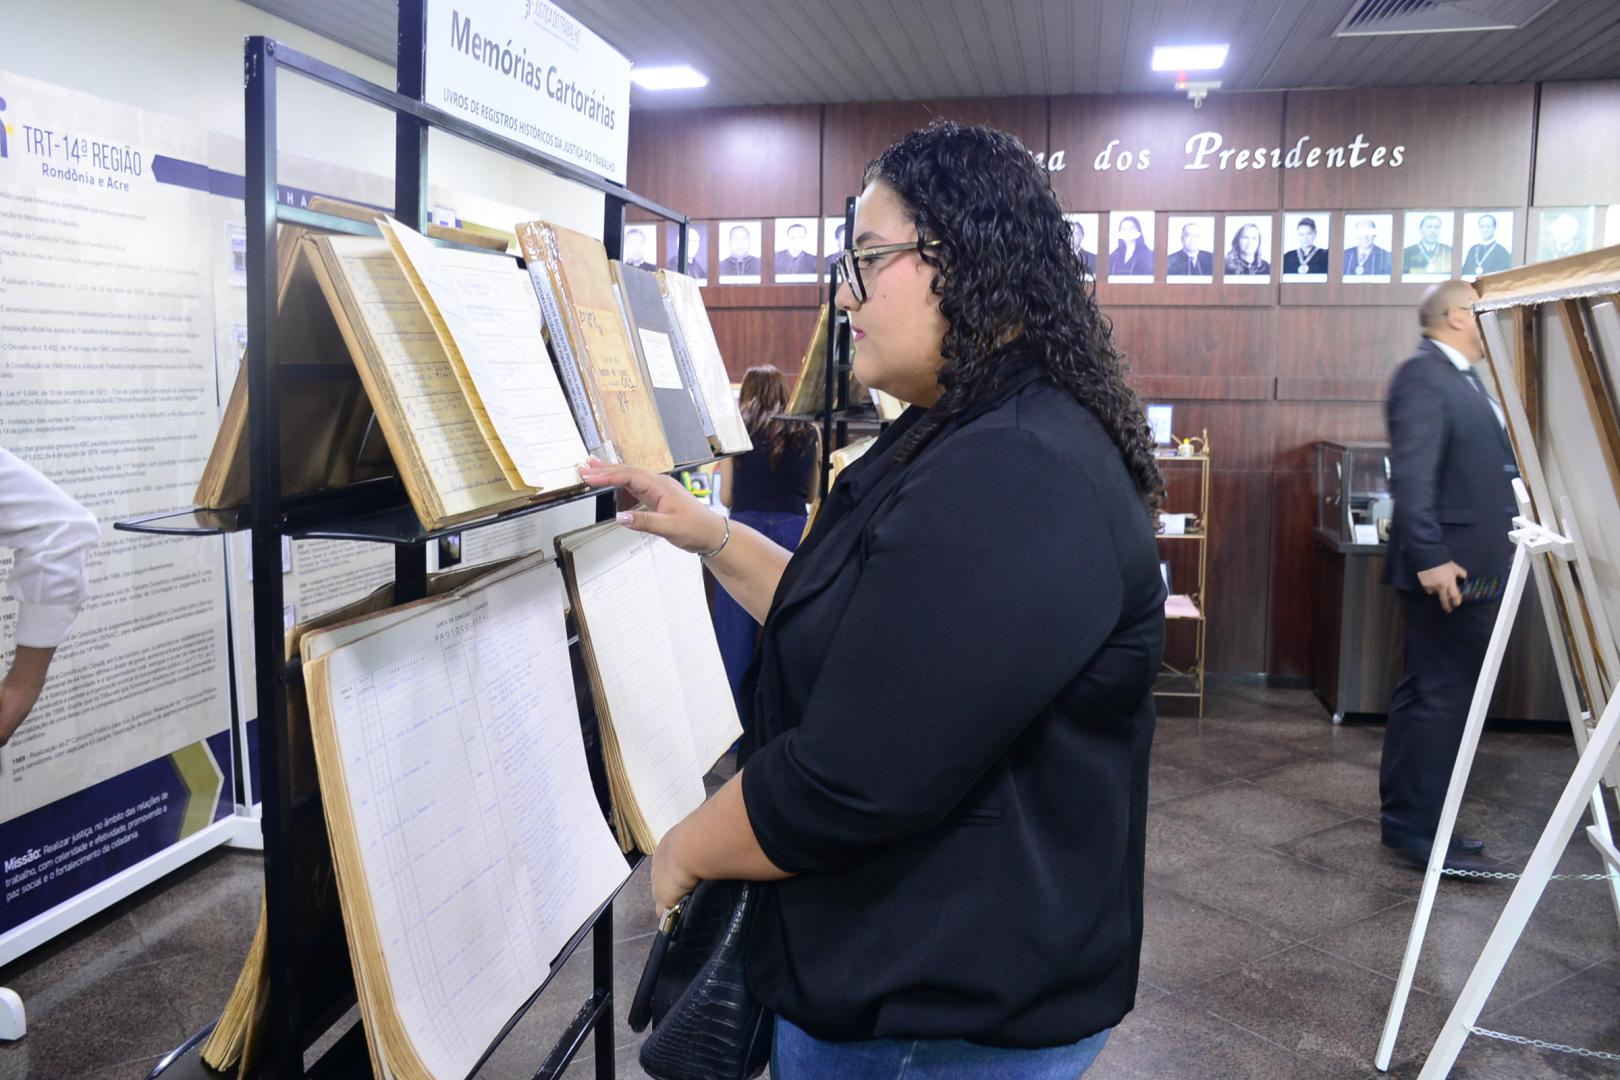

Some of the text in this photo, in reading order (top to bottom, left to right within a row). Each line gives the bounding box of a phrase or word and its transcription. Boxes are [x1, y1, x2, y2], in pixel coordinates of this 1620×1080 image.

[450, 9, 615, 130] Memórias Cartorárias
[443, 86, 616, 173] LIVROS DE REGISTROS HISTÓRICOS DA JUSTIÇA DO TRABALHO
[92, 141, 142, 177] REGIÃO
[1093, 139, 1151, 171] dos
[1183, 131, 1405, 170] Presidentes
[42, 163, 130, 192] Rondônia e Acre
